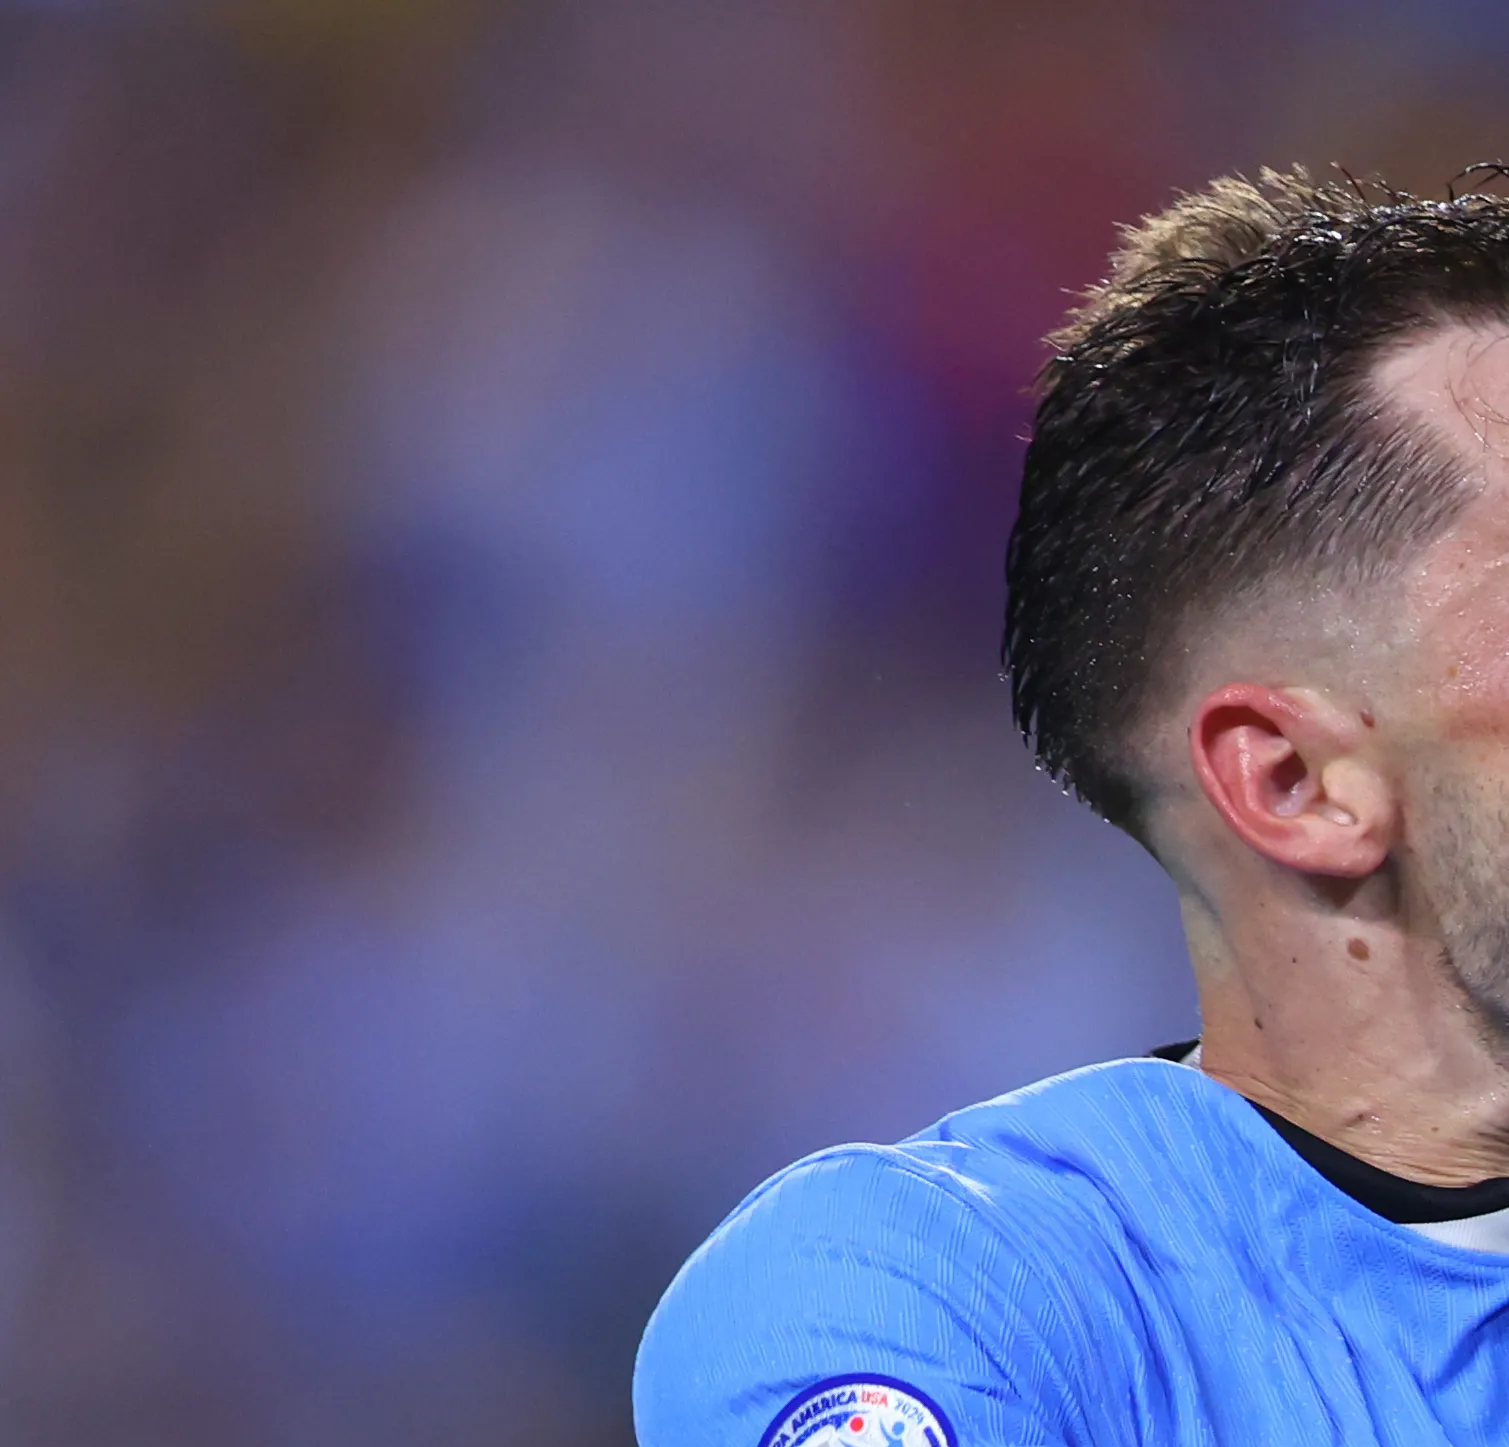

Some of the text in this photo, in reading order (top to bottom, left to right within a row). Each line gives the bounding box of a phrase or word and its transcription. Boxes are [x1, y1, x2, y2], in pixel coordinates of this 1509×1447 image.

[792, 1390, 858, 1433] AMERICA
[861, 1391, 889, 1408] USA
[895, 1398, 925, 1424] 2024
